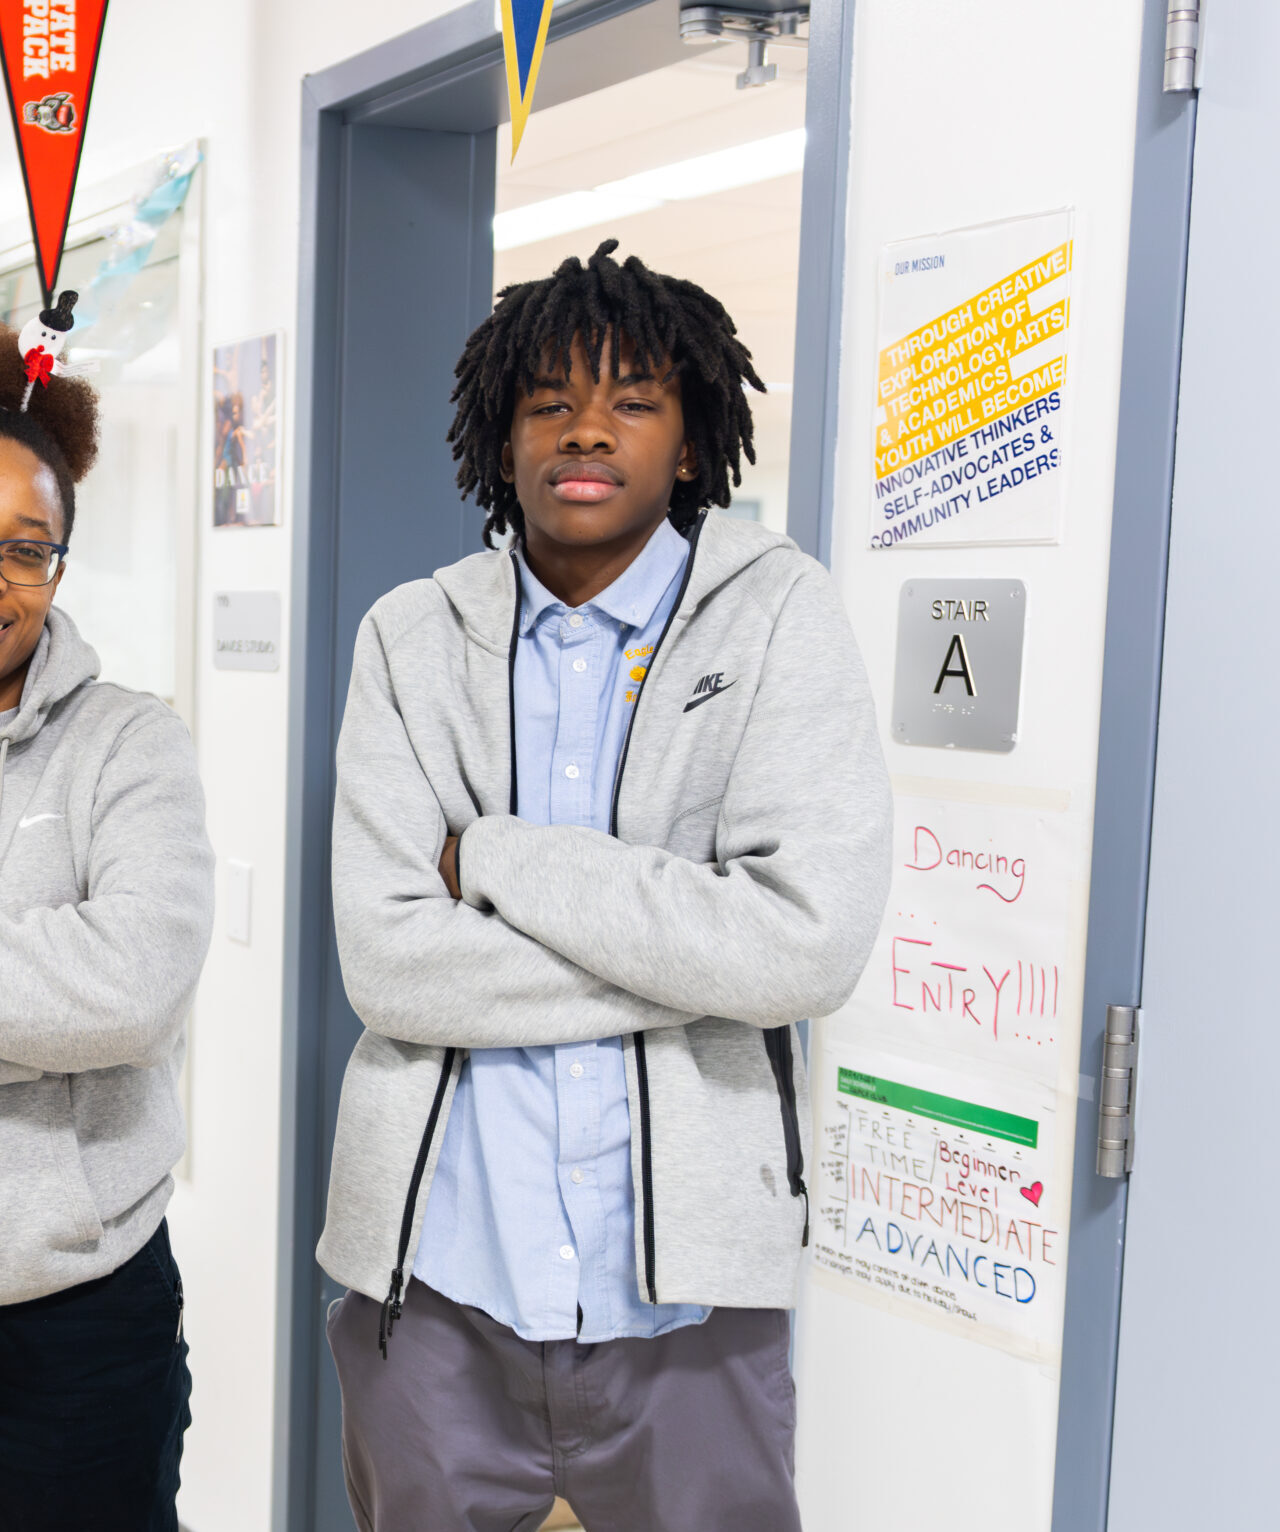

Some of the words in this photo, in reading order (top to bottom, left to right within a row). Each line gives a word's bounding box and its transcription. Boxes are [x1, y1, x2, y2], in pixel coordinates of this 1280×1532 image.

[50, 0, 76, 72] TATE
[894, 262, 910, 276] OUR
[912, 255, 945, 271] MISSION
[887, 305, 974, 367] THROUGH
[976, 250, 1066, 316] CREATIVE
[880, 326, 998, 398] EXPLORATION
[1001, 300, 1028, 328] OF
[888, 342, 1012, 416] TECHNOLOGY,
[1014, 307, 1065, 346] ARTS
[875, 427, 934, 473] YOUTH
[936, 409, 980, 445] WILL
[983, 360, 1063, 415] BECOME
[880, 427, 893, 448] &
[897, 365, 1009, 439] ACADEMICS
[875, 439, 968, 500] INNOVATIVE
[970, 391, 1061, 450] THINKERS
[884, 433, 1036, 520] SELF-ADVOCATES
[1040, 425, 1055, 443] &
[871, 489, 971, 549] COMMUNITY
[931, 600, 990, 621] STAIR
[933, 633, 978, 697] A
[904, 826, 1025, 903] Dancing
[858, 1115, 913, 1151] FREE
[864, 1143, 929, 1183] TIME
[938, 1140, 1020, 1183] Beginner
[850, 1163, 1059, 1266] INTERMEDIATE
[945, 1172, 999, 1208] Level
[855, 1217, 1036, 1304] ADVANCED
